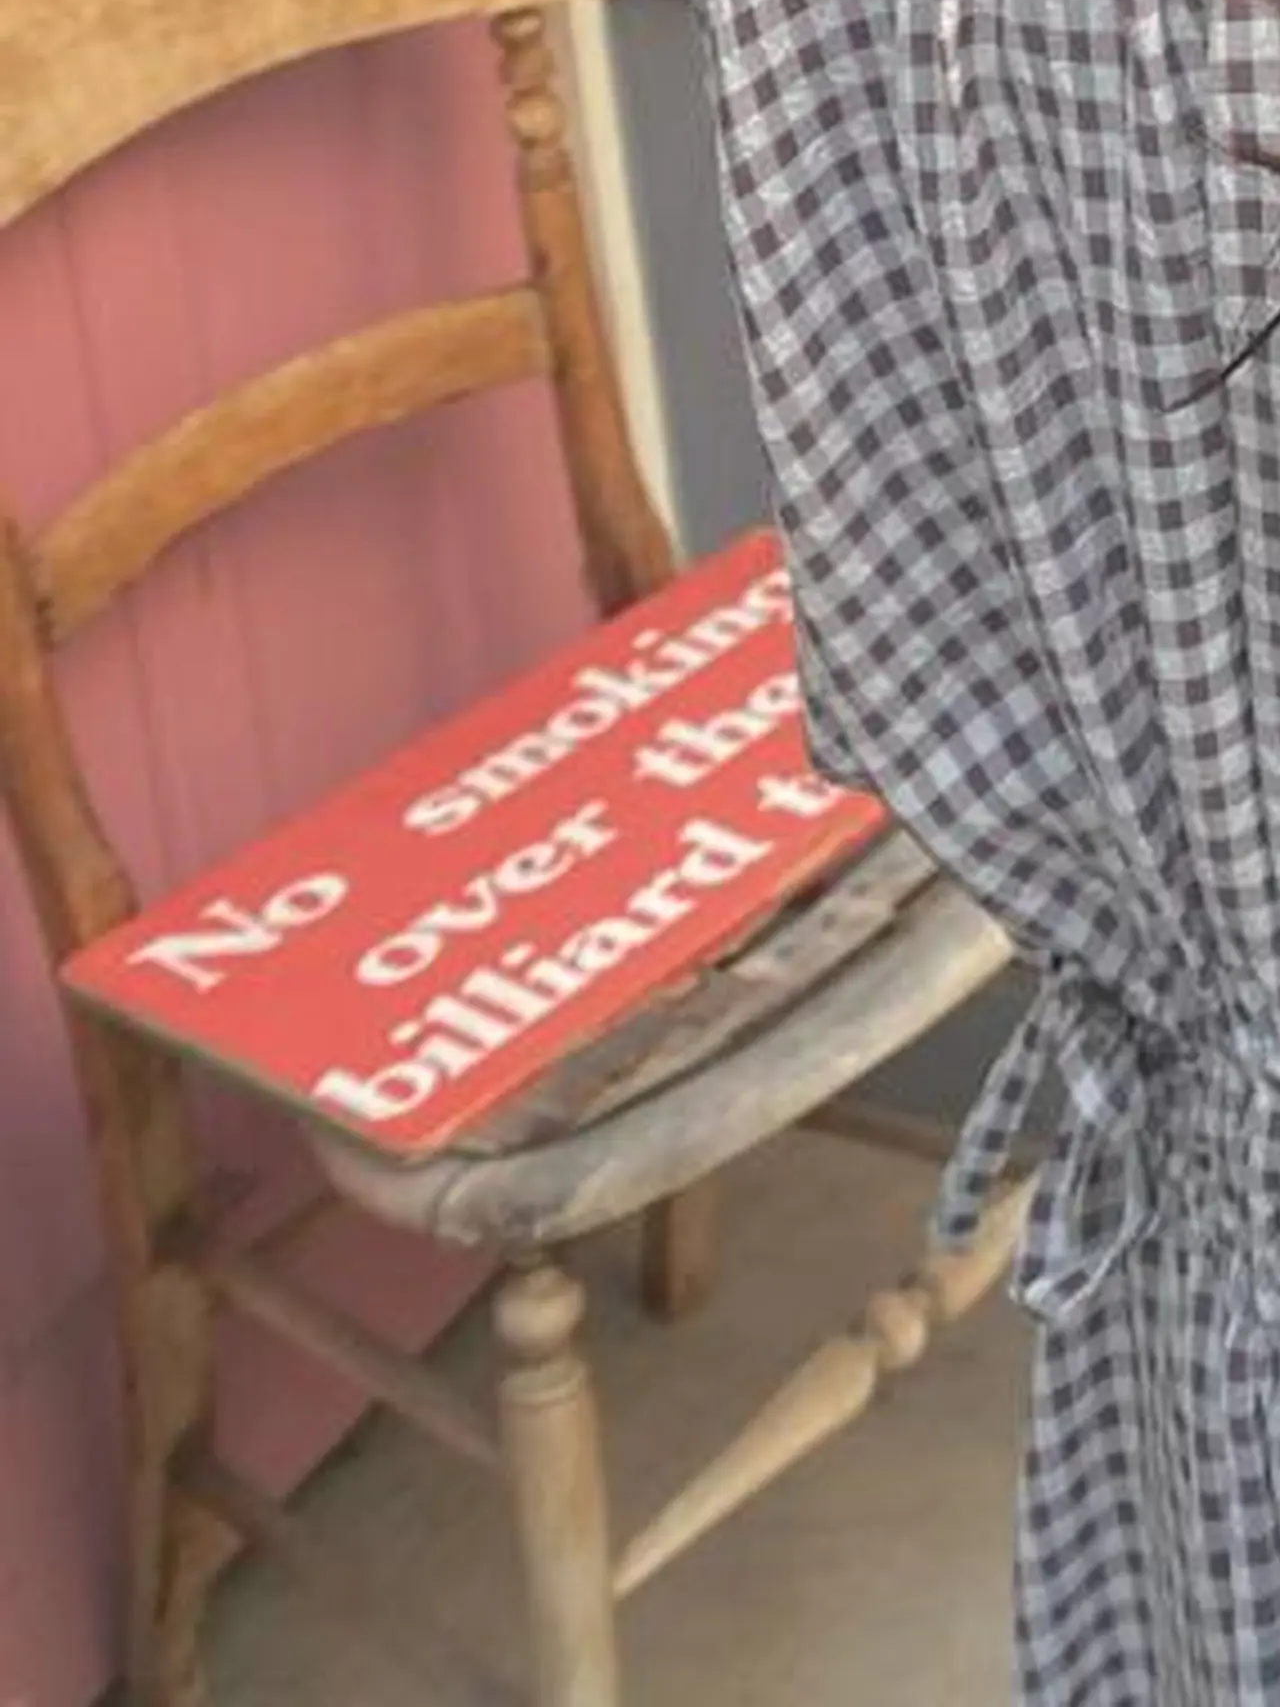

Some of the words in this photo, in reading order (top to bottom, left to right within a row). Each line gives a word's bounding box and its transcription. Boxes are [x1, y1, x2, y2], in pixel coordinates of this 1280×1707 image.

[126, 872, 349, 993] No
[311, 819, 774, 1122] billiard
[354, 798, 618, 987] over
[633, 673, 801, 788] the
